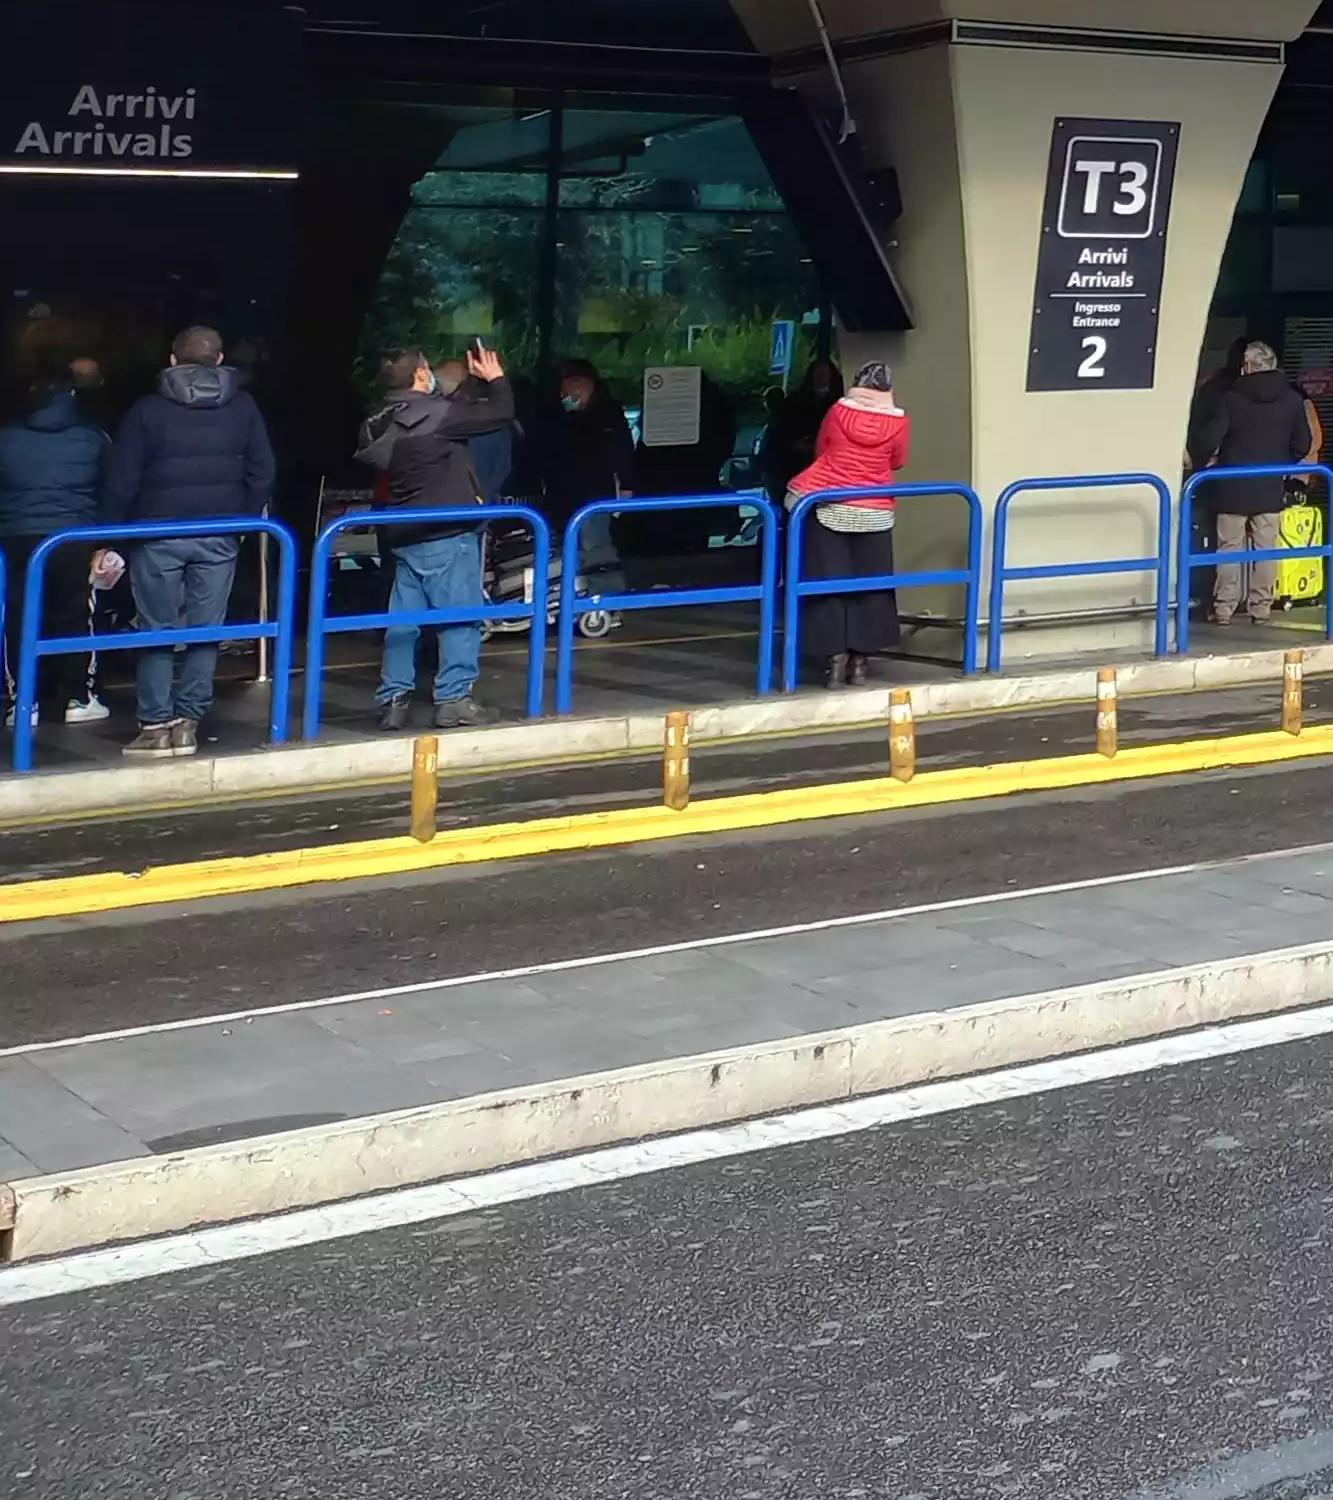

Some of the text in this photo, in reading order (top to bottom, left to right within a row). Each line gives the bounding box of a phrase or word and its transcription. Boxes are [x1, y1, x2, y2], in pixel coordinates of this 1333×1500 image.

[67, 84, 197, 120] Arrivi
[14, 121, 193, 157] Arrivals
[1075, 160, 1149, 215] T3
[1078, 247, 1129, 265] Arrivi
[1066, 270, 1134, 288] Arrivals
[1074, 301, 1121, 314] Ingresso
[1072, 316, 1120, 327] Entrance
[1076, 335, 1108, 378] 2
